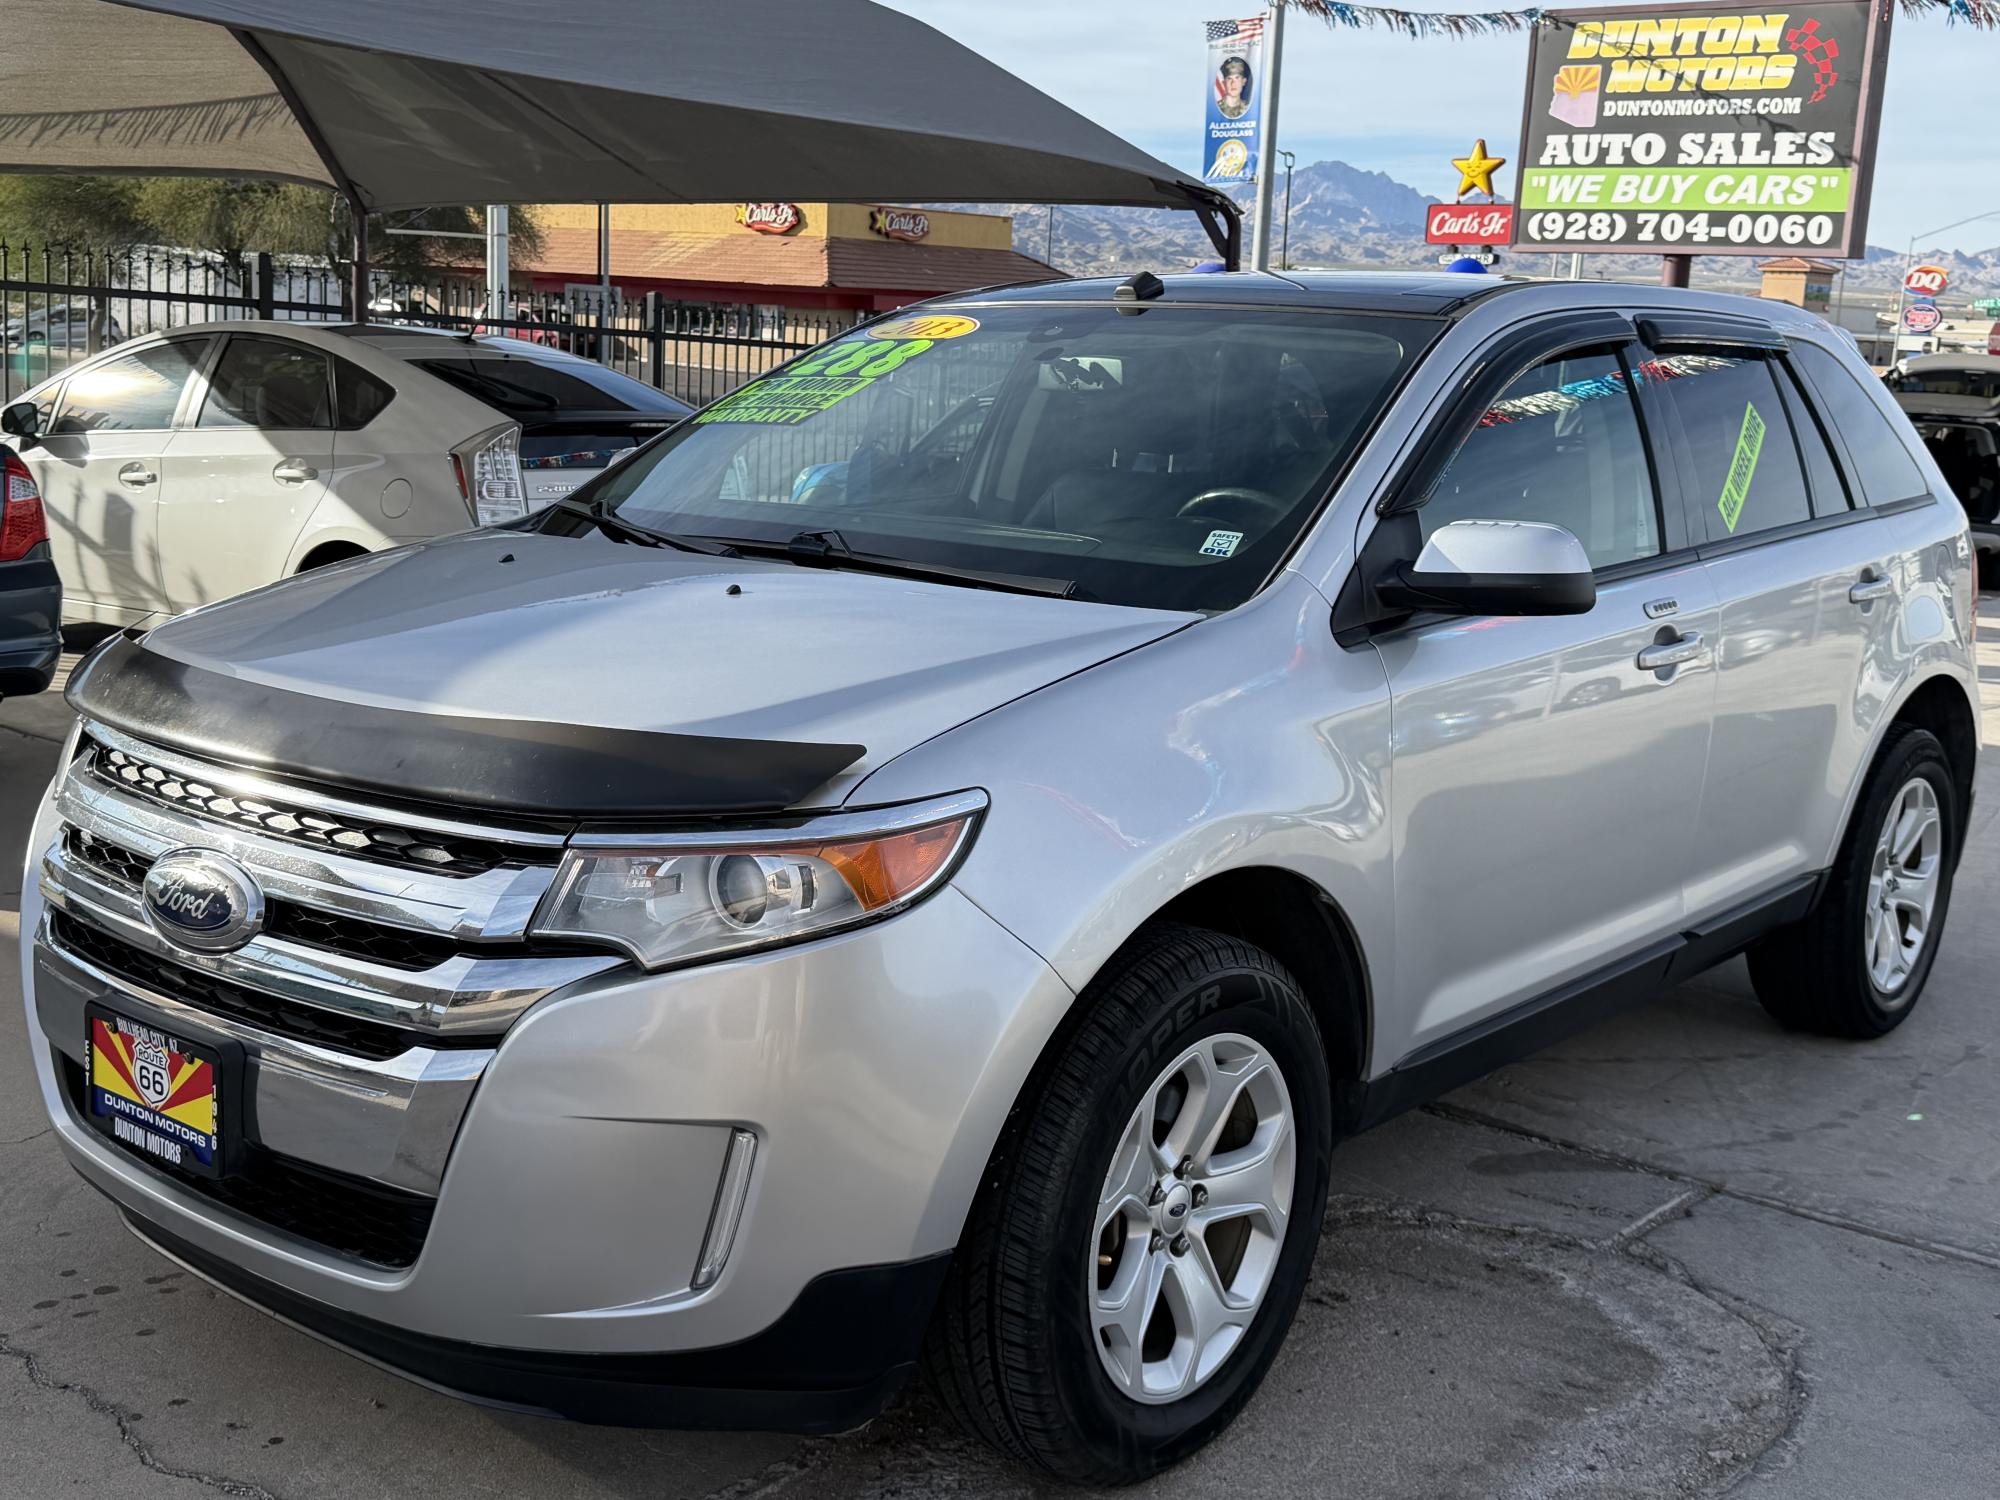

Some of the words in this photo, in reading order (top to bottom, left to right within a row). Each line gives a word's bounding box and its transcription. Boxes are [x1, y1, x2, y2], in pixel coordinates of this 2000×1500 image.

[1566, 14, 1789, 58] DUNTON
[1605, 54, 1797, 93] MOTORS
[1602, 97, 1802, 117] DUNTONMOTORS.COM
[1209, 121, 1256, 130] ALEXANDER
[1539, 132, 1667, 165] AUTO
[1677, 131, 1836, 165] SALES
[1531, 174, 1606, 203] "WE
[1611, 174, 1699, 204] BUY
[1704, 174, 1839, 206] CARS"
[1430, 211, 1481, 236] Carl's
[1527, 212, 1627, 242] (928)
[1637, 213, 1833, 245] 704-0060
[1908, 271, 1942, 291] DQ
[878, 321, 965, 336] 2013
[745, 393, 842, 406] FINANCE
[691, 408, 818, 424] WARRANTY
[154, 875, 215, 920] Ford
[137, 1047, 165, 1068] ROUTE
[168, 1037, 180, 1053] AZ
[139, 1065, 165, 1097] 66
[104, 1093, 154, 1125] DUNTON
[155, 1114, 206, 1148] MOTORS
[114, 1116, 147, 1149] DUNTON
[147, 1131, 182, 1165] MOTORS
